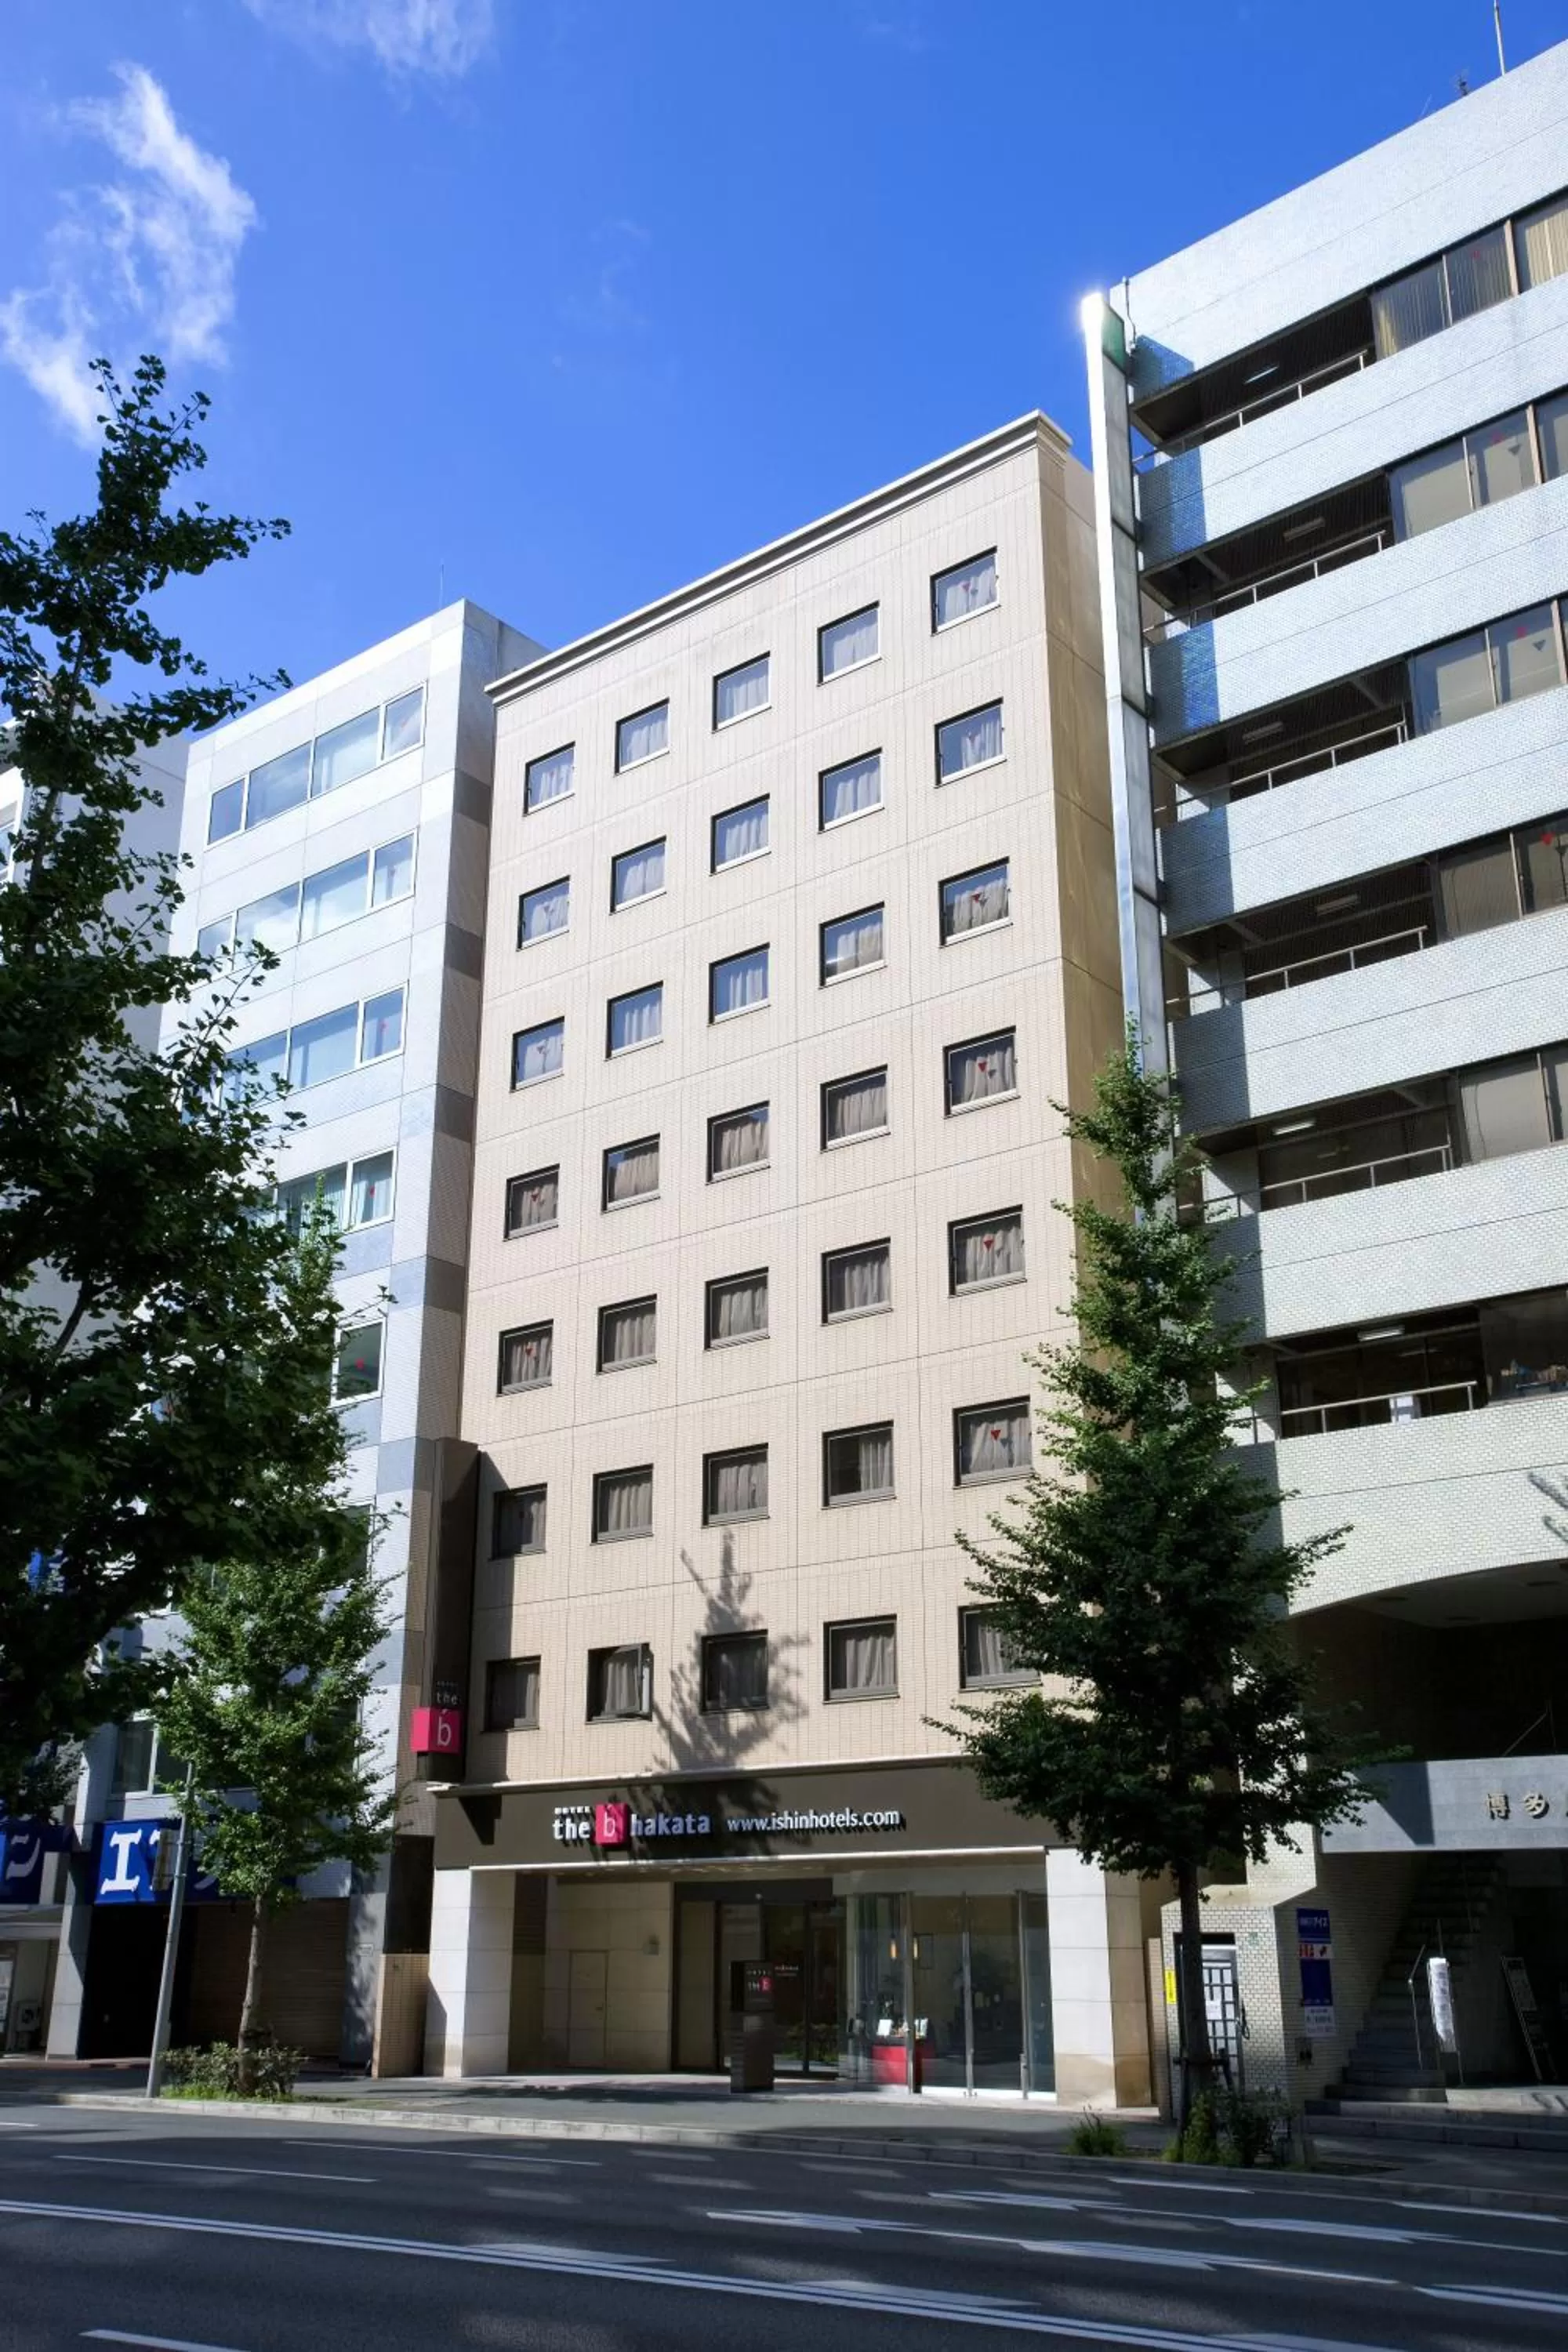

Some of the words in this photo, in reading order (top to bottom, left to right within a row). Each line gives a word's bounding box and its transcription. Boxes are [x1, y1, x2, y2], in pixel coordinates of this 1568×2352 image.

[437, 1716, 452, 1746] b
[1485, 1791, 1568, 1819] 博多
[552, 1818, 590, 1840] the
[630, 1813, 712, 1837] hakata
[727, 1807, 901, 1832] www.ishinhotels.com
